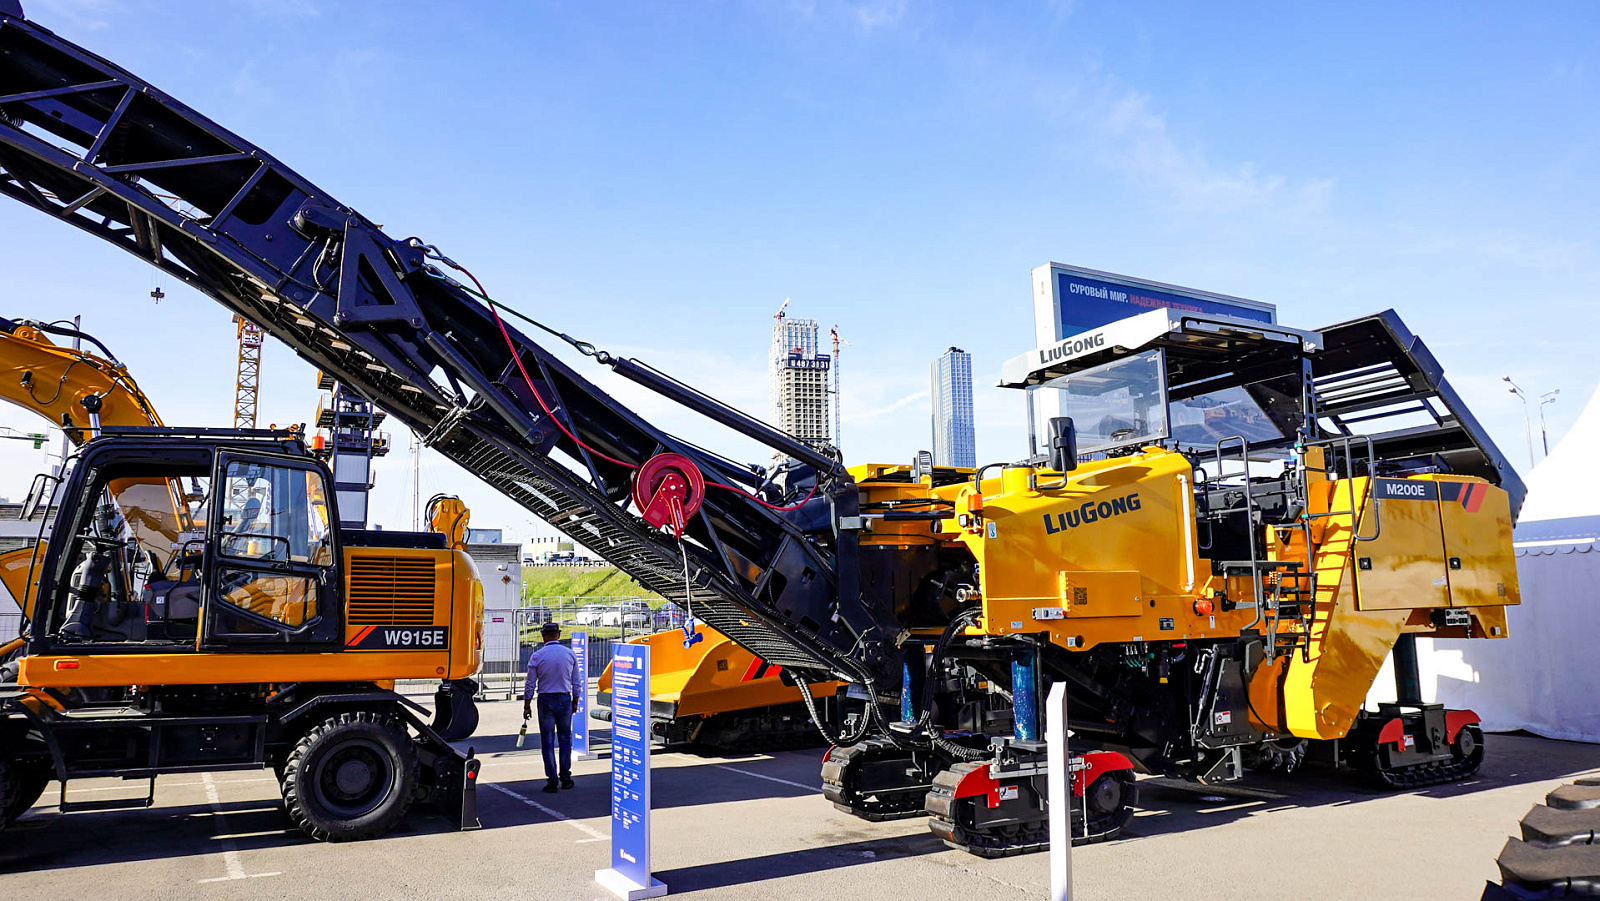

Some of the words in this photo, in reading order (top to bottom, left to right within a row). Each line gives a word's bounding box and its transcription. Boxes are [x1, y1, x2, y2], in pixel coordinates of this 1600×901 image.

[1069, 282, 1109, 300] СУРОВЫЙ
[1109, 290, 1129, 303] МИР.
[1386, 483, 1425, 496] M200E
[384, 630, 444, 645] W915E
